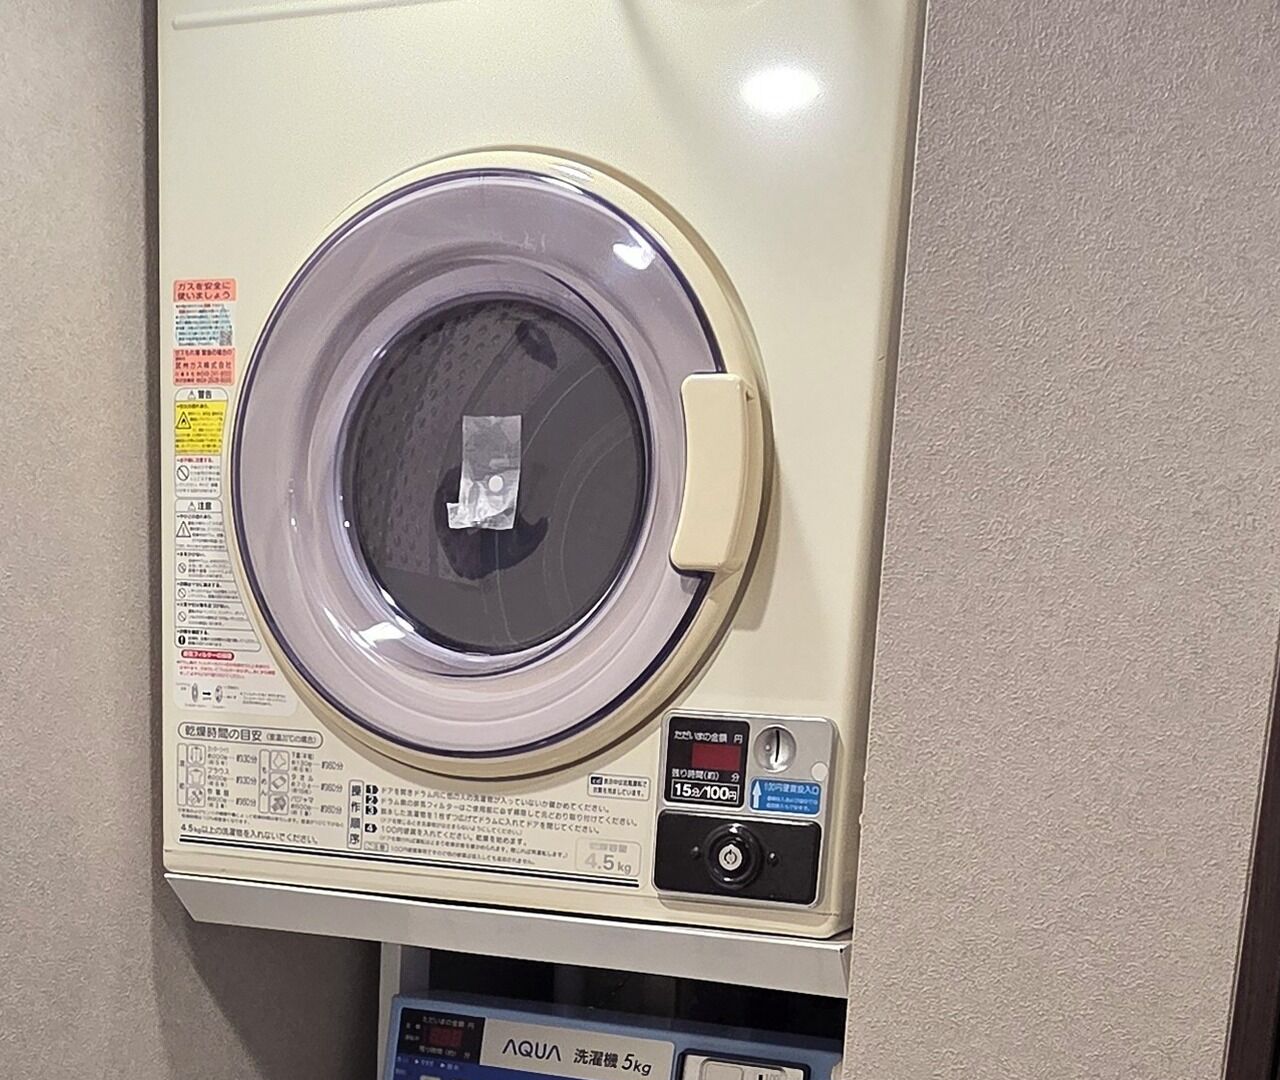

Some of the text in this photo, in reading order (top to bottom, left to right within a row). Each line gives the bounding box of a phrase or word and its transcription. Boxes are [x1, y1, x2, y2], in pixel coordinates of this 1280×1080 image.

[185, 725, 262, 741] 乾燥時間の目安
[674, 730, 744, 744] ただいまの金額 円
[731, 773, 740, 783] 分
[674, 782, 737, 801] 15分/100円
[584, 852, 632, 875] 4.5 kg
[502, 1038, 561, 1063] AQUA
[573, 1048, 652, 1076] 洗濯機 5kg
